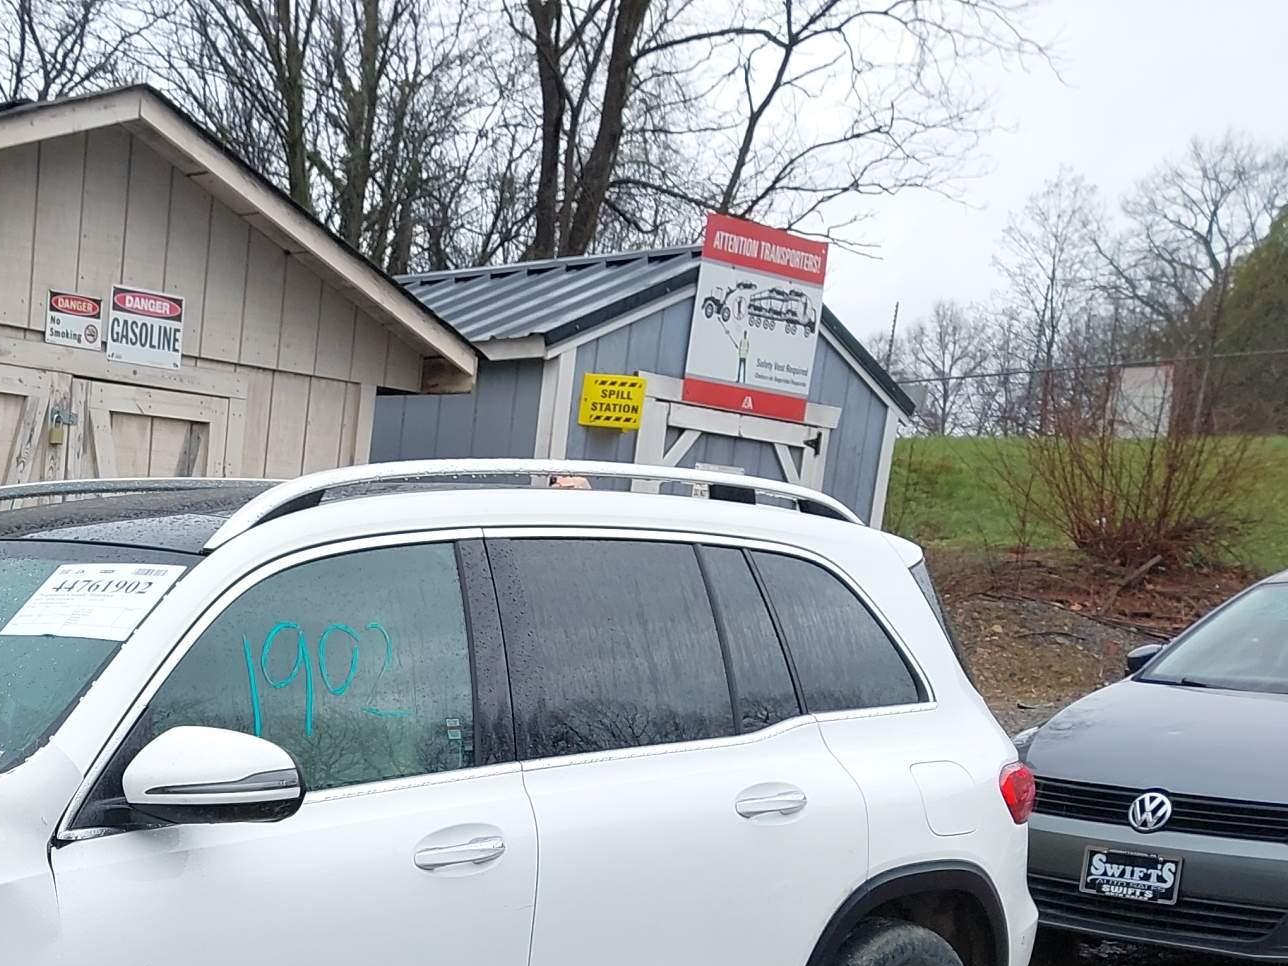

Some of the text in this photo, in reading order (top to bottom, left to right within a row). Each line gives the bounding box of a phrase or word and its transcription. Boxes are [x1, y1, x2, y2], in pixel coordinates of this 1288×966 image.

[713, 231, 822, 274] ATTENTION TRANSPORTERS!
[57, 296, 93, 314] DANGER
[125, 294, 170, 315] DANGER
[50, 315, 61, 326] No
[49, 327, 82, 345] Smoking
[111, 317, 182, 353] GASOLINE
[756, 358, 773, 372] Safety
[786, 364, 809, 377] Required
[600, 388, 633, 401] SPILL
[590, 401, 639, 414] STATION
[52, 579, 155, 595] 44761902
[242, 621, 413, 738] 1902
[1101, 884, 1154, 898] SWIFT'S
